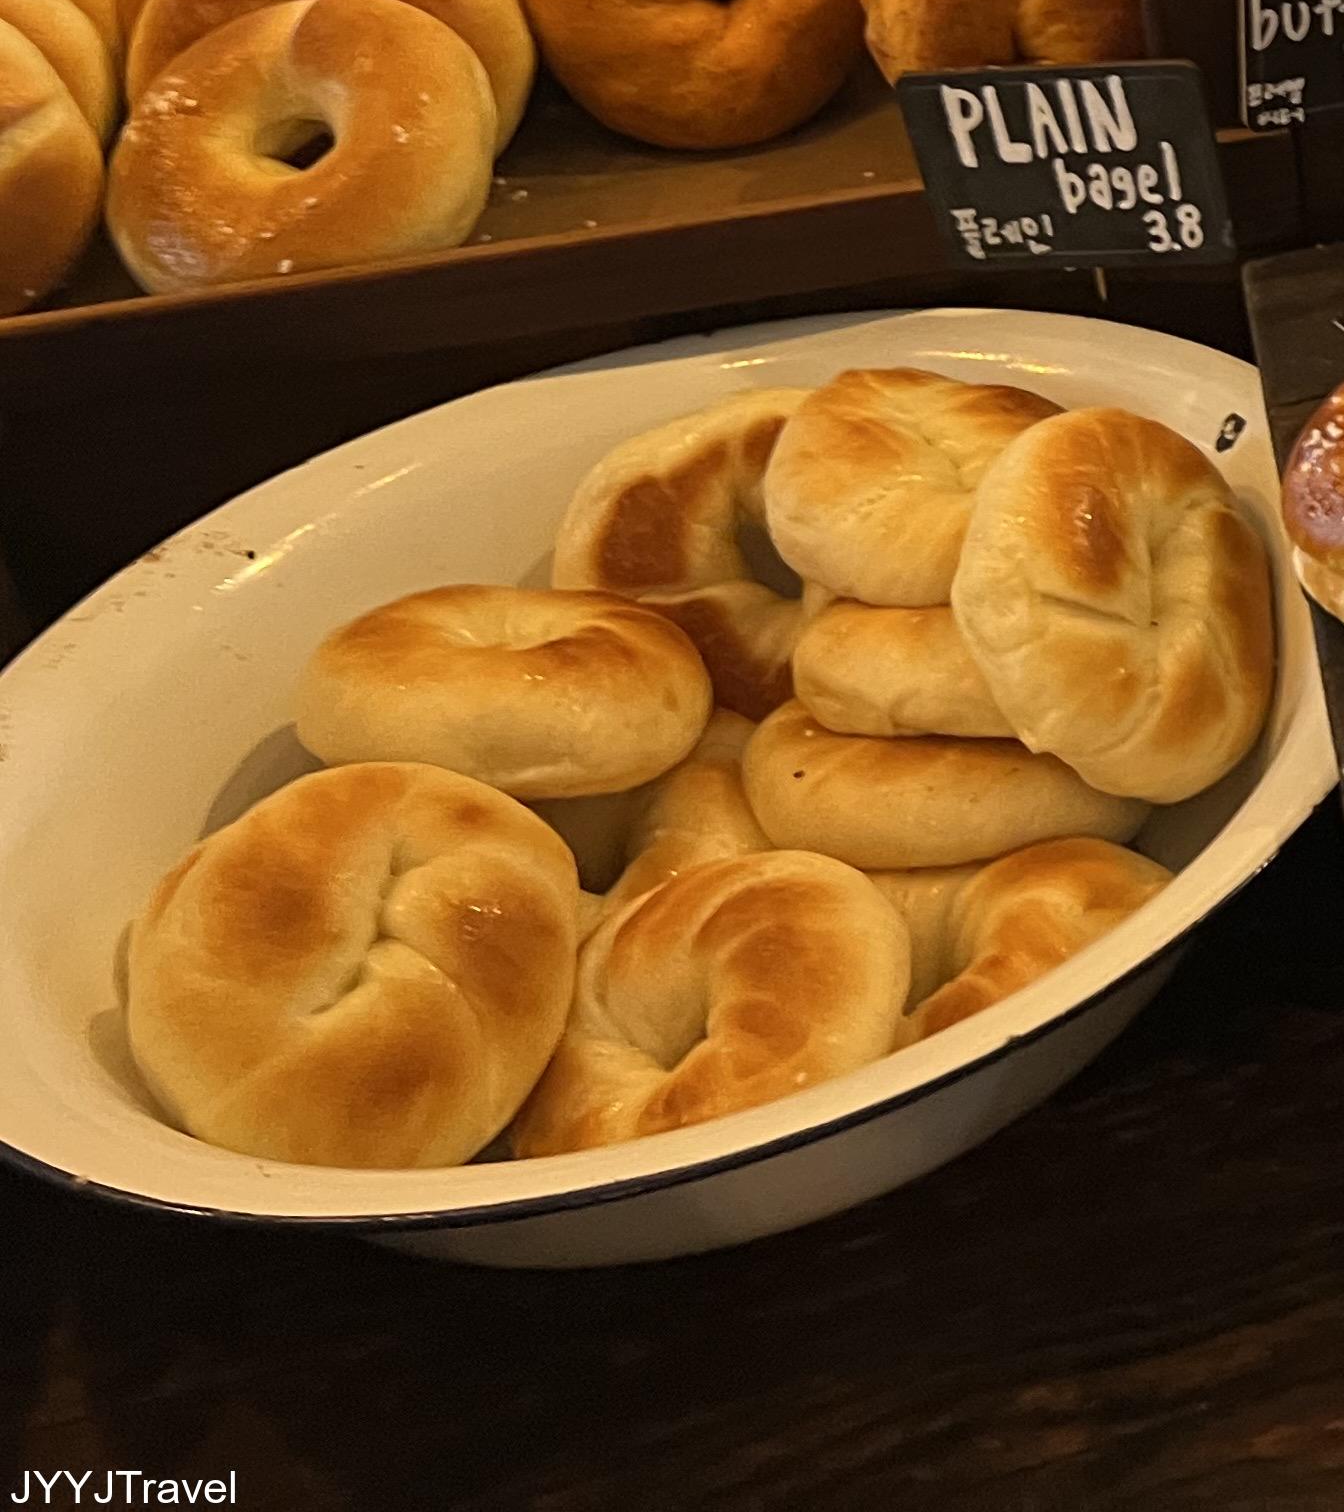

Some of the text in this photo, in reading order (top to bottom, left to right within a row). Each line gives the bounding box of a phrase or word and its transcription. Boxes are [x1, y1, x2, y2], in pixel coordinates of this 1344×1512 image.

[939, 74, 1138, 169] PLAIN
[1053, 141, 1183, 215] bagel
[1142, 203, 1205, 254] 3.8
